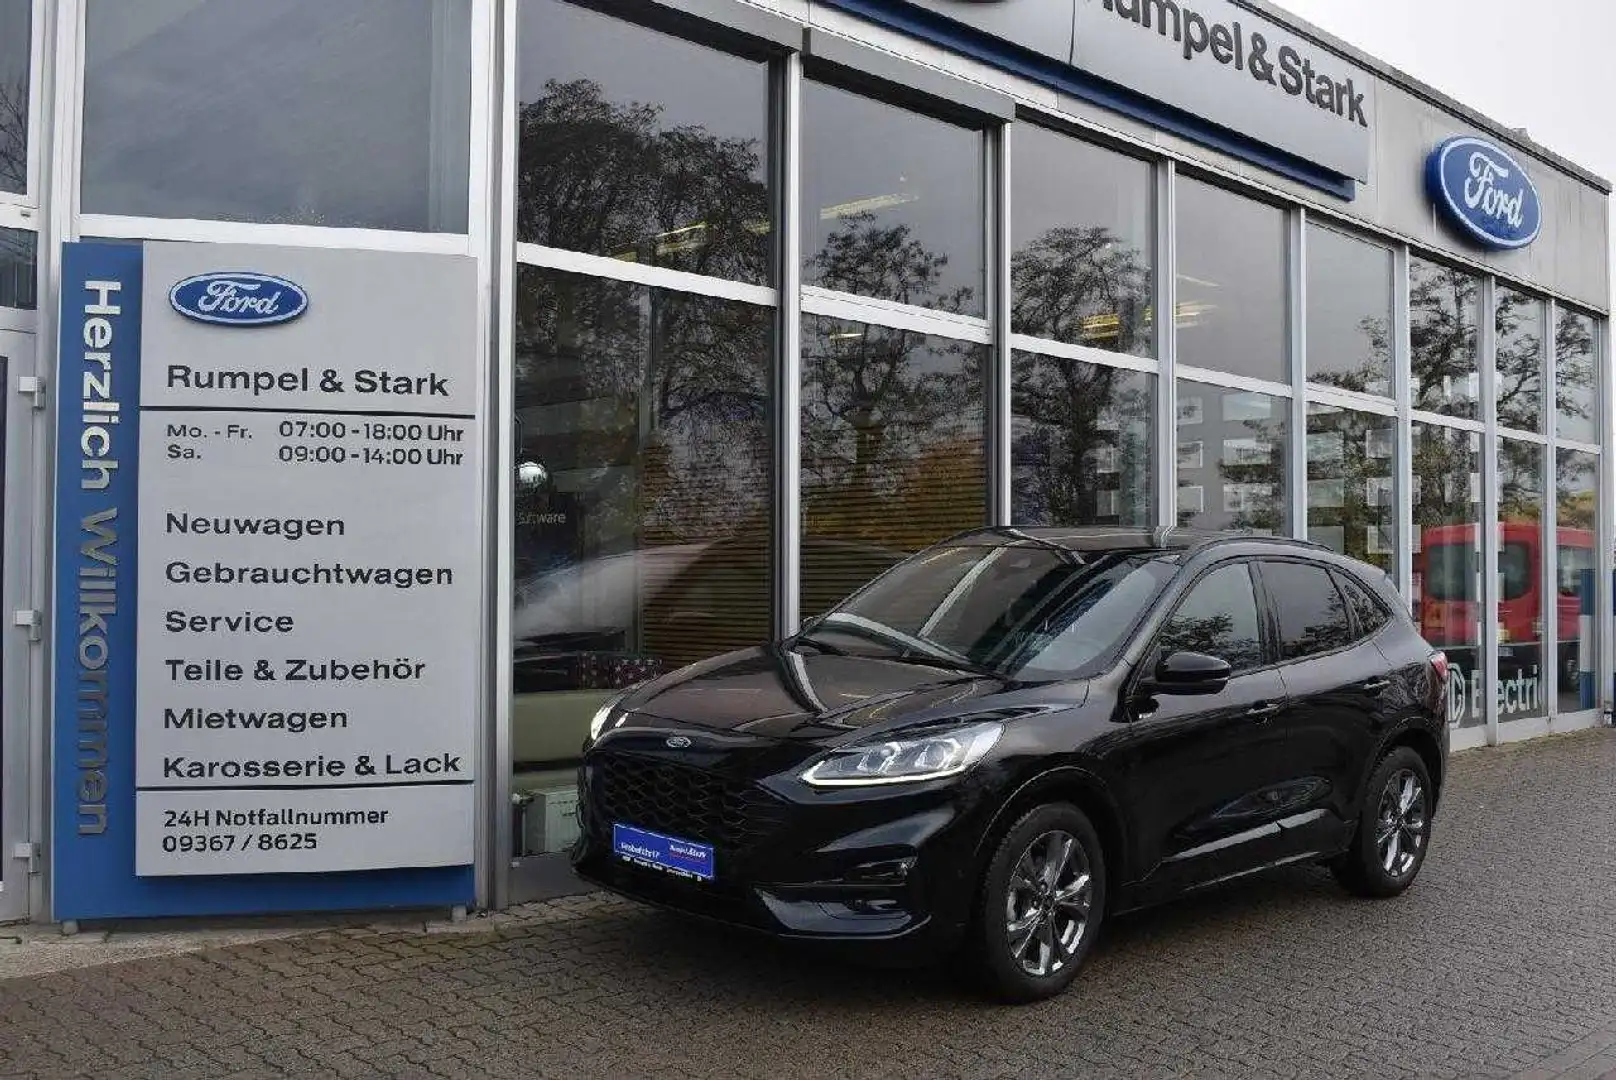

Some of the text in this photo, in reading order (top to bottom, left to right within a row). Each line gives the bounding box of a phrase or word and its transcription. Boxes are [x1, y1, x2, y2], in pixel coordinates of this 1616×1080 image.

[1103, 0, 1368, 127] umpel & Stark
[1464, 151, 1524, 228] Ford
[198, 280, 281, 314] Ford
[167, 364, 449, 397] Rumpel & Stark
[167, 424, 207, 438] Mo.
[227, 424, 252, 439] Fr.
[279, 420, 346, 439] 07:00
[363, 423, 422, 441] 18:00
[427, 424, 464, 442] Uhr
[167, 444, 202, 460] Sa.
[279, 445, 346, 464] 09:00
[363, 447, 422, 465] 14:00
[427, 448, 464, 466] Uhr
[167, 513, 345, 541] Neuwagen
[78, 279, 121, 835] Herzlich Willkommen
[166, 561, 453, 589] Gebrauchtwagen
[165, 610, 294, 633] Service
[165, 658, 426, 681] Teile & Zubehör
[164, 707, 348, 734] Mietwagen
[163, 752, 461, 779] Karosserie & Lack
[161, 808, 389, 828] 24H Notfallnummer
[162, 832, 317, 853] 09367 / 8625
